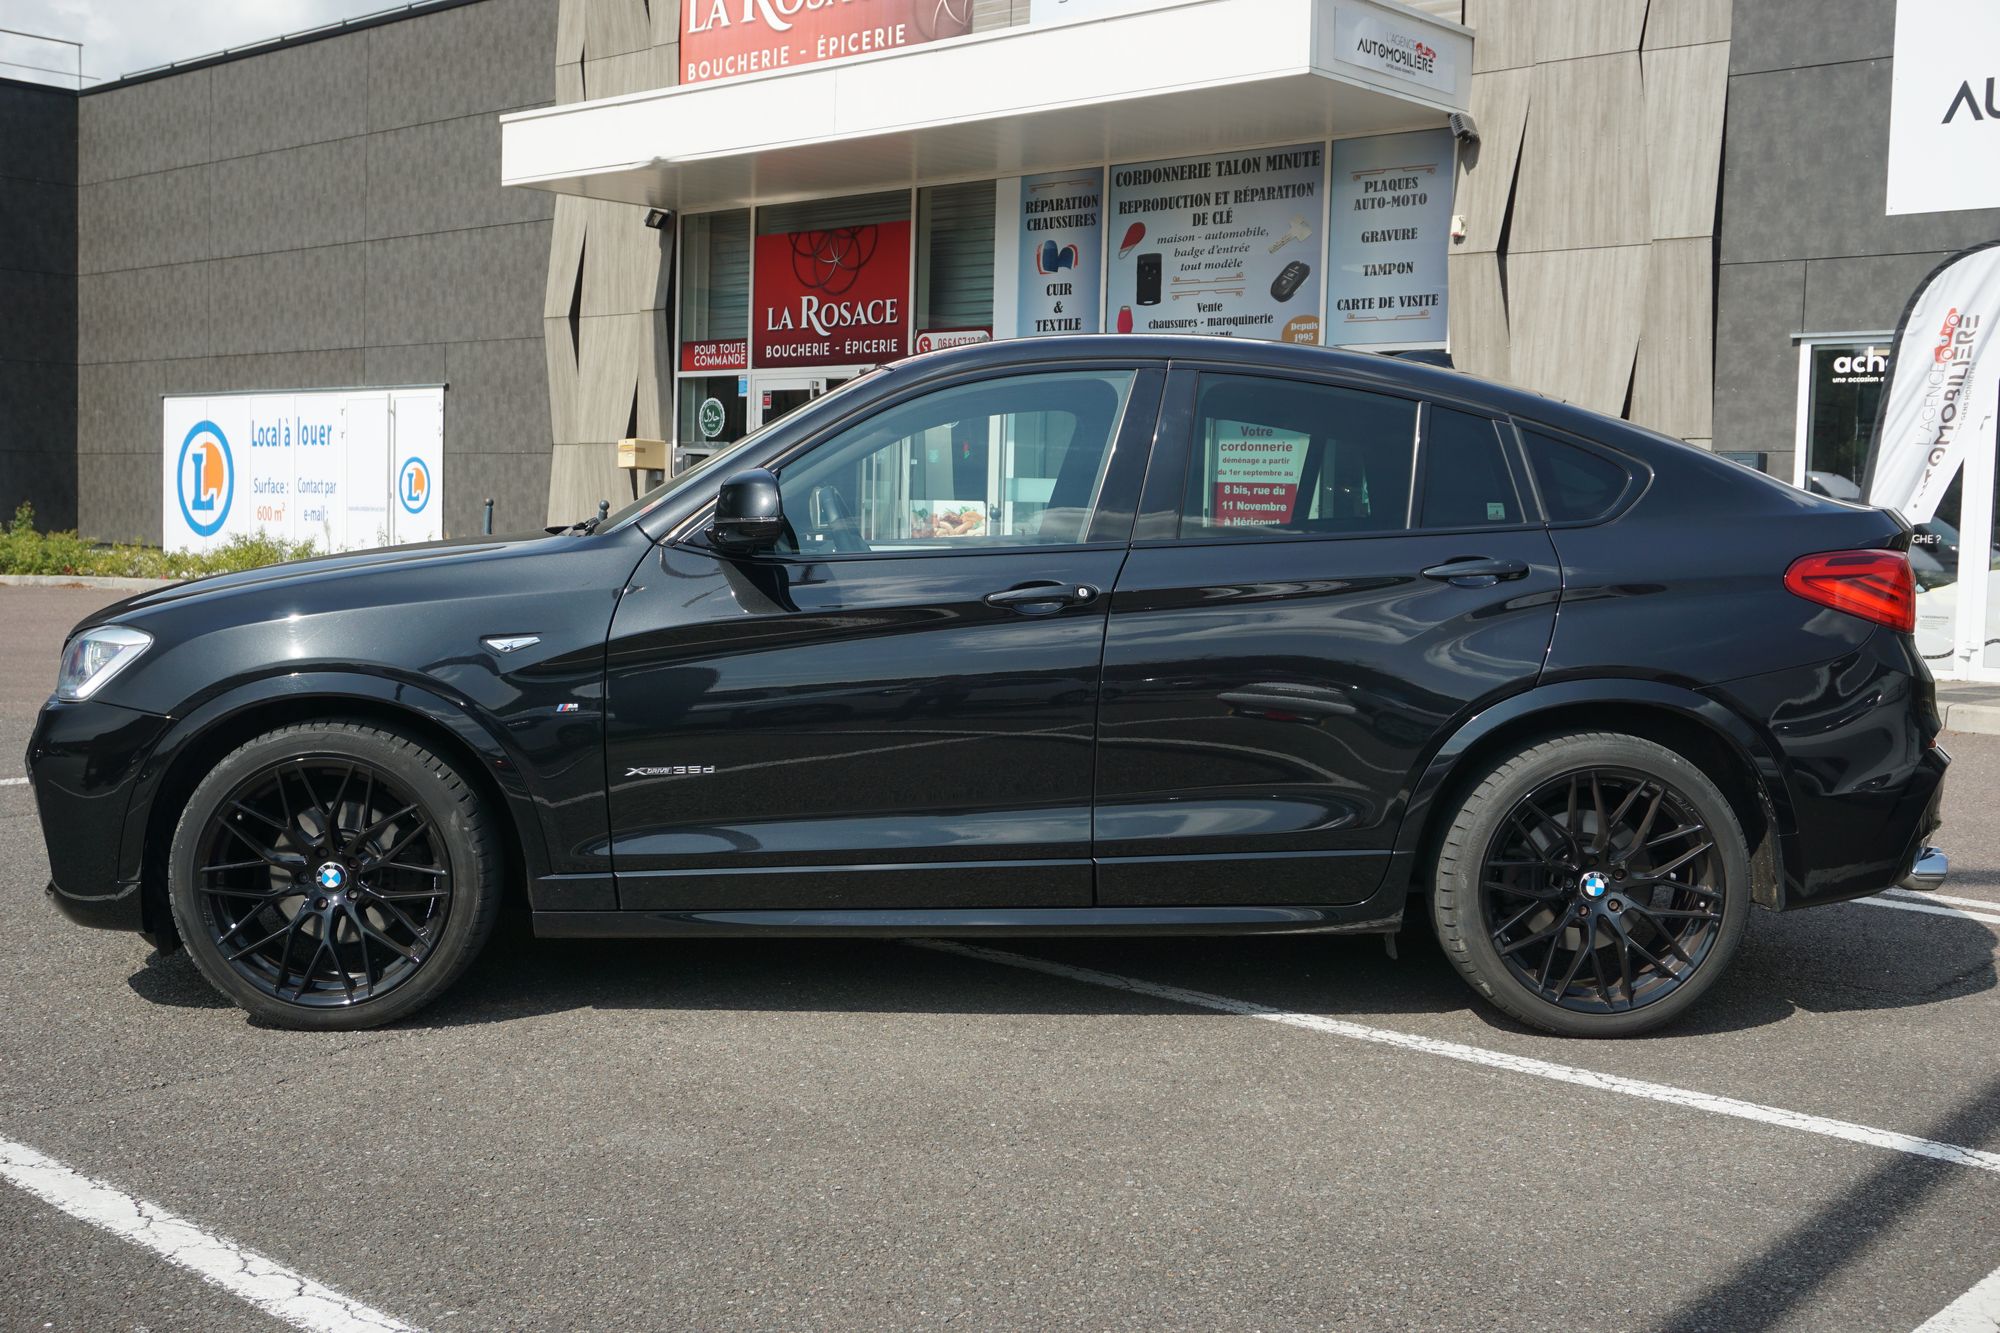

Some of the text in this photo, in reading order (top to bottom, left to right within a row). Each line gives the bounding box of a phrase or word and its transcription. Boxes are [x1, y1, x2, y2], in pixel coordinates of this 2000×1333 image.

[688, 46, 789, 81] BOUCHERIE
[817, 24, 906, 58] ÉPICERIE
[1115, 150, 1321, 188] CORDONNERIE TALON MINUTE
[1364, 176, 1419, 194] PLAQUES
[1025, 194, 1099, 214] RÉPARATION
[1119, 182, 1315, 215] REPRODUCTION ET RÉPARATION
[1354, 192, 1428, 211] AUTO-MOTO
[1027, 213, 1097, 232] CHAUSSURES
[1192, 207, 1233, 227] DE CLÉ
[1157, 233, 1195, 245] maison
[1205, 227, 1269, 241] automobile,
[1361, 227, 1418, 244] GRAVURE
[1174, 242, 1251, 259] badge d'entrée
[1180, 258, 1243, 271] tout modèle
[1363, 261, 1414, 277] TAMPON
[1046, 282, 1072, 297] CUIR
[1053, 301, 1063, 313] &
[1197, 302, 1223, 313] Vente
[1336, 293, 1439, 312] CARTE DE VISITE
[767, 296, 899, 337] LA ROSACE
[1036, 317, 1081, 332] TEXTILE
[1148, 317, 1198, 330] chaussures
[1207, 313, 1274, 328] maroquinerie
[1291, 321, 1319, 331] Depuis
[1294, 332, 1314, 343] 1995
[694, 342, 746, 355] POUR TOUTE
[766, 340, 830, 358] BOUCHERIE
[844, 338, 898, 355] ÉPICERIE
[694, 354, 746, 367] COMMANDE
[1833, 346, 1889, 373] ach
[1848, 375, 1879, 383] occasion
[252, 416, 332, 447] Local à louer
[1240, 426, 1273, 437] Votre
[1220, 441, 1293, 452] cordonnerie
[1269, 457, 1291, 465] partir
[254, 477, 285, 494] Surface
[298, 477, 337, 498] Contact par
[1224, 485, 1285, 496] 8 bis, rue du
[257, 505, 273, 521] 600
[304, 505, 325, 521] e-mail
[1222, 501, 1287, 512] 11 Novembre
[1224, 516, 1231, 526] à
[1935, 534, 1942, 544] ?
